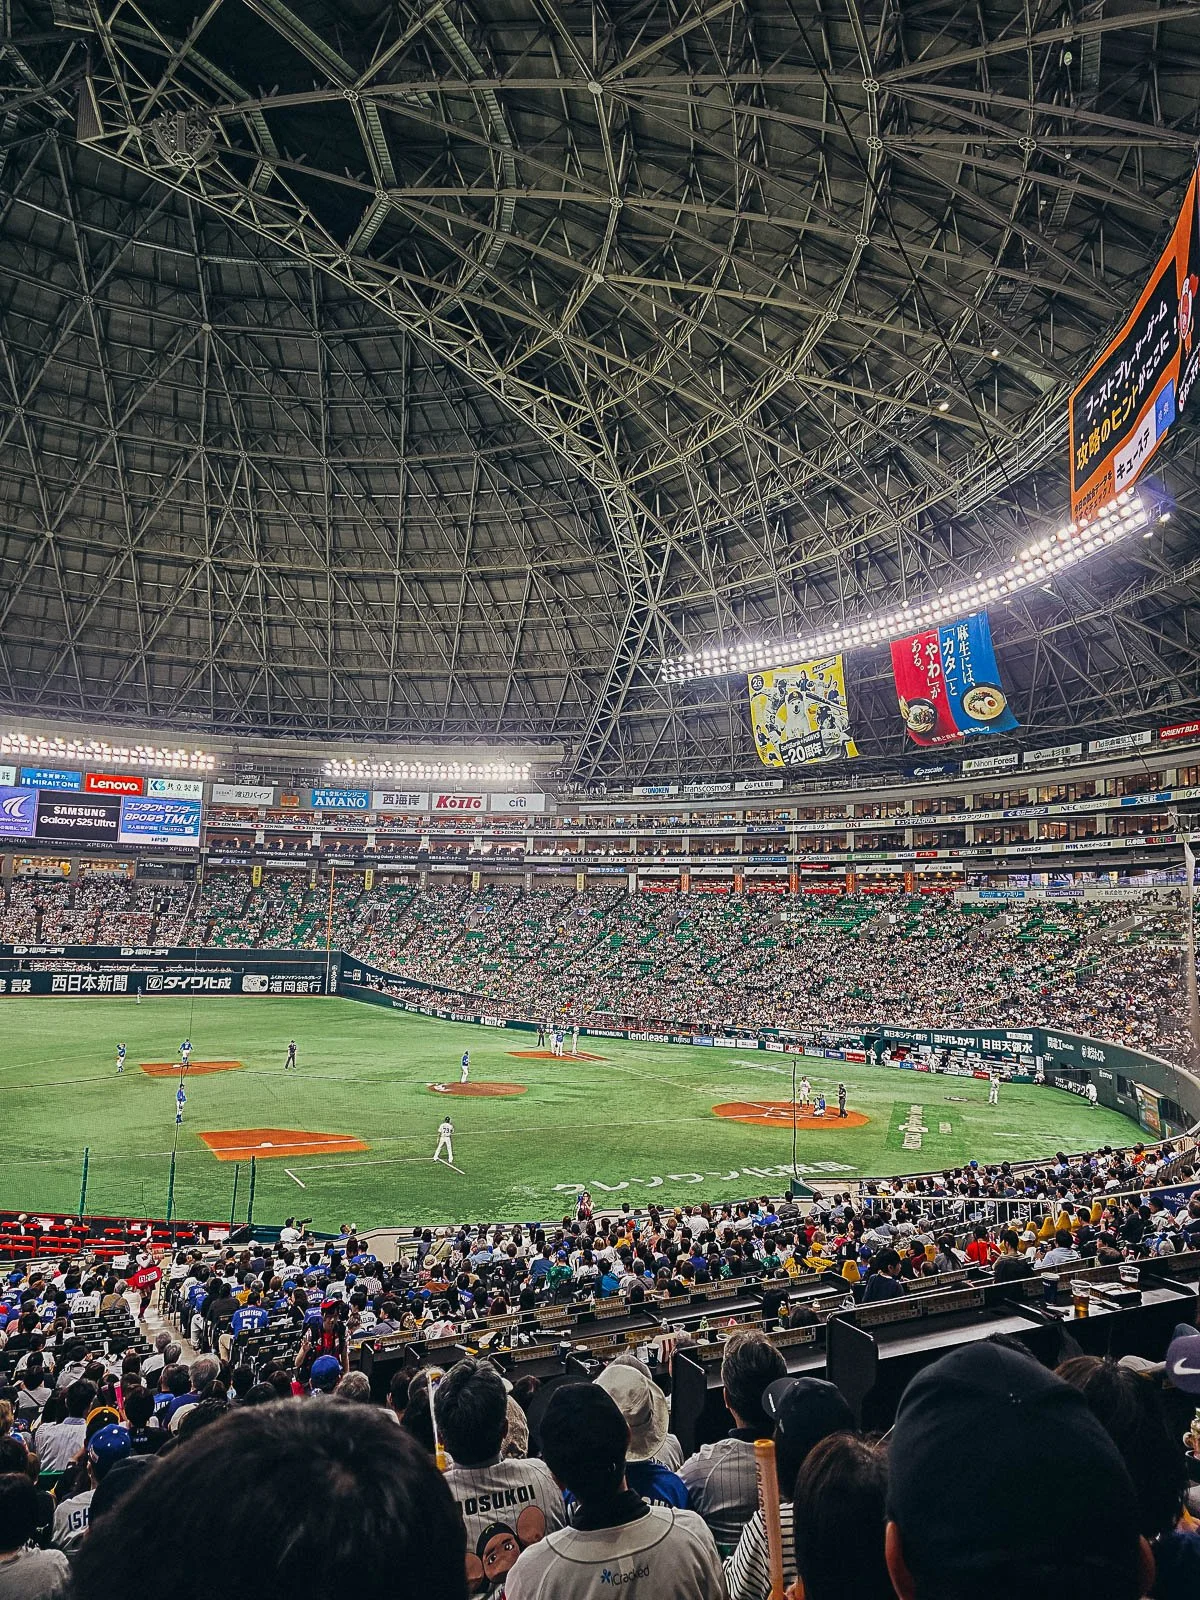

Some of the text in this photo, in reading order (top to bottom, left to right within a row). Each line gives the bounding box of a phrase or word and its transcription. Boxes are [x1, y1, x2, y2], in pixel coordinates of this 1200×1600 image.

[1116, 428, 1150, 479] キューステ
[911, 639, 924, 671] ある。
[942, 628, 958, 695] 「カタ」と
[957, 624, 976, 686] 麻生には、
[925, 634, 941, 699] 「やわ」が
[1161, 727, 1183, 738] ORIENT
[974, 756, 1016, 768] Nihon Forest
[90, 778, 139, 791] Lenovo
[684, 784, 731, 793] transcosmos
[314, 797, 366, 808] AMANO
[382, 793, 420, 806] 西海岸
[509, 796, 527, 808] citi
[53, 806, 106, 817] SAMSUNG
[125, 802, 199, 813] コンタクトセンター
[1061, 802, 1078, 811] NEC
[40, 815, 116, 828] Galaxy S25 Ultra
[52, 974, 128, 992] 西日本新聞
[164, 976, 232, 990] ダイワ化成
[270, 980, 322, 993] 福岡銀行
[628, 1030, 669, 1043] lendlease
[884, 1030, 927, 1041] 西日本シティ銀行
[934, 1034, 975, 1047] ヨドバシカメラ
[982, 1038, 1033, 1053] 日田天領水
[242, 1317, 258, 1329] 51
[460, 1485, 536, 1516] OSUKOI
[611, 1567, 650, 1587] iCracked
